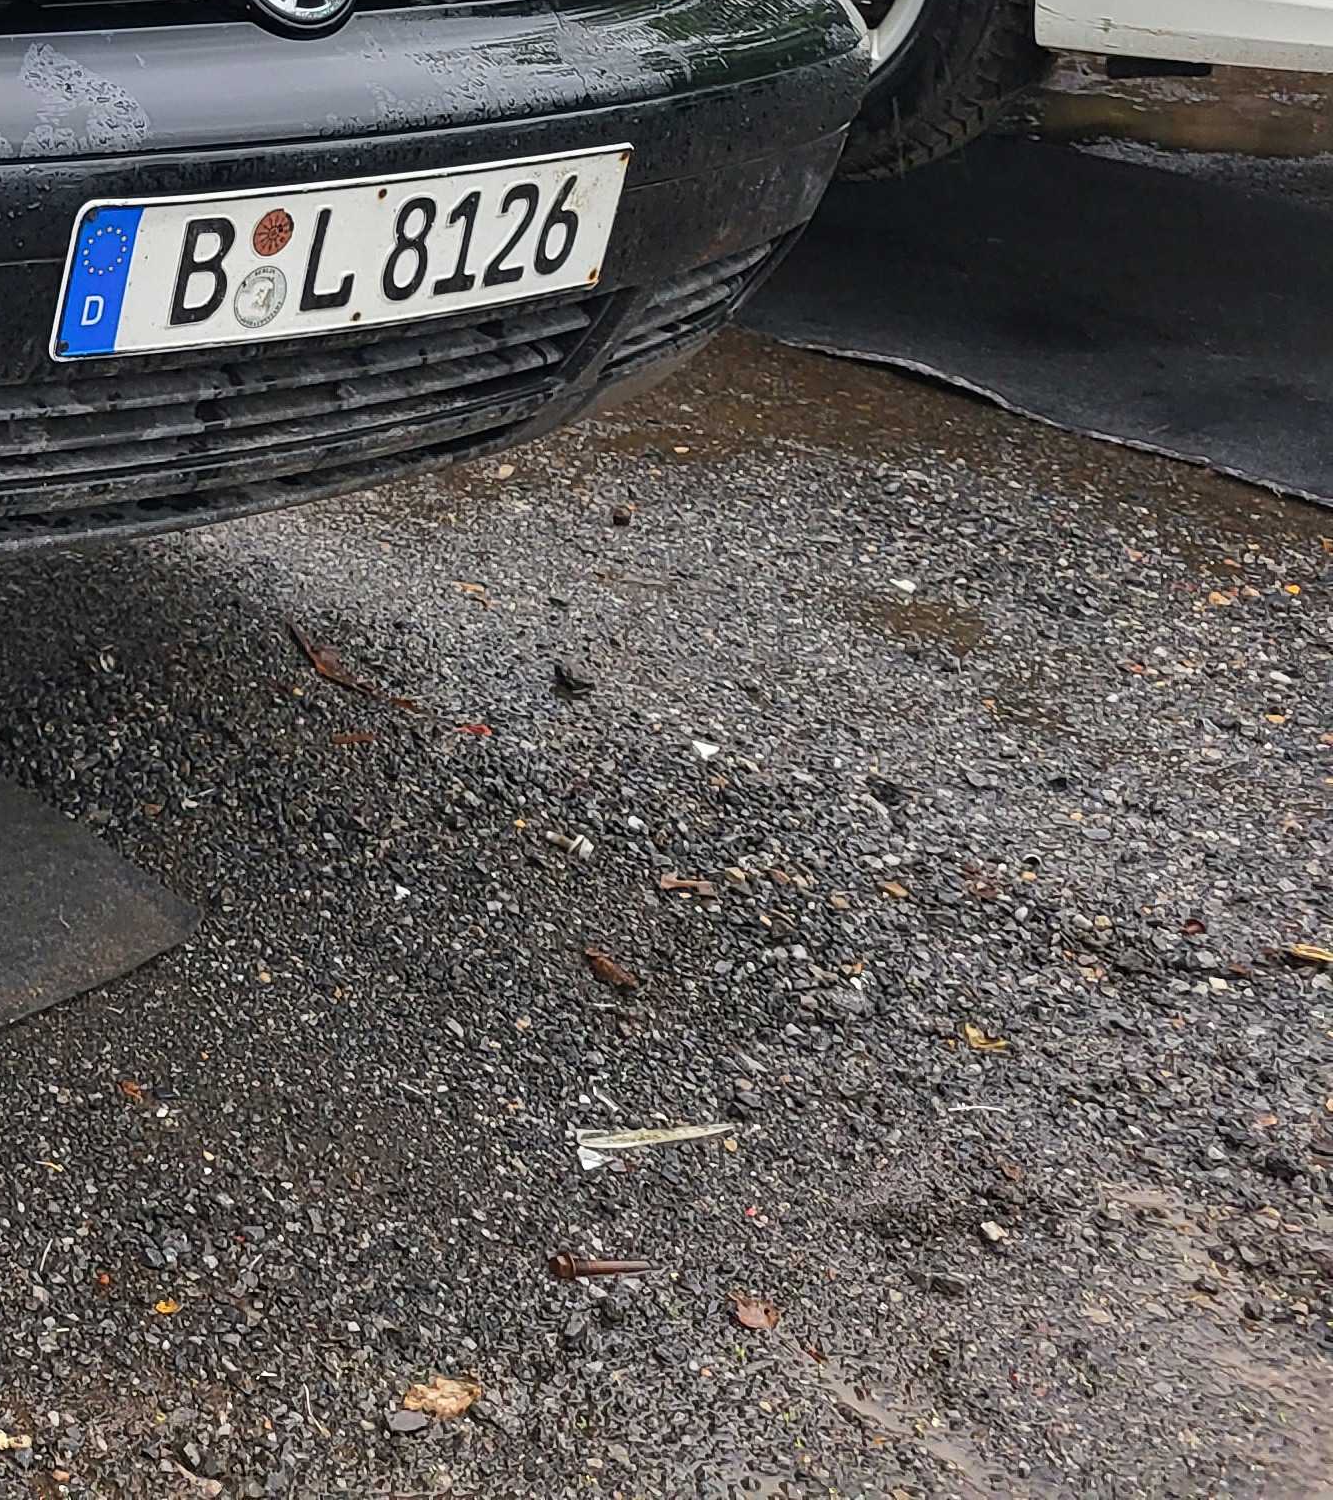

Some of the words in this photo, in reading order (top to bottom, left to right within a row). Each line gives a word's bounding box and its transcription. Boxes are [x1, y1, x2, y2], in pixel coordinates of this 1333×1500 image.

[169, 216, 235, 326] B
[298, 206, 356, 313] L
[381, 174, 580, 301] 8126
[80, 295, 105, 326] D
